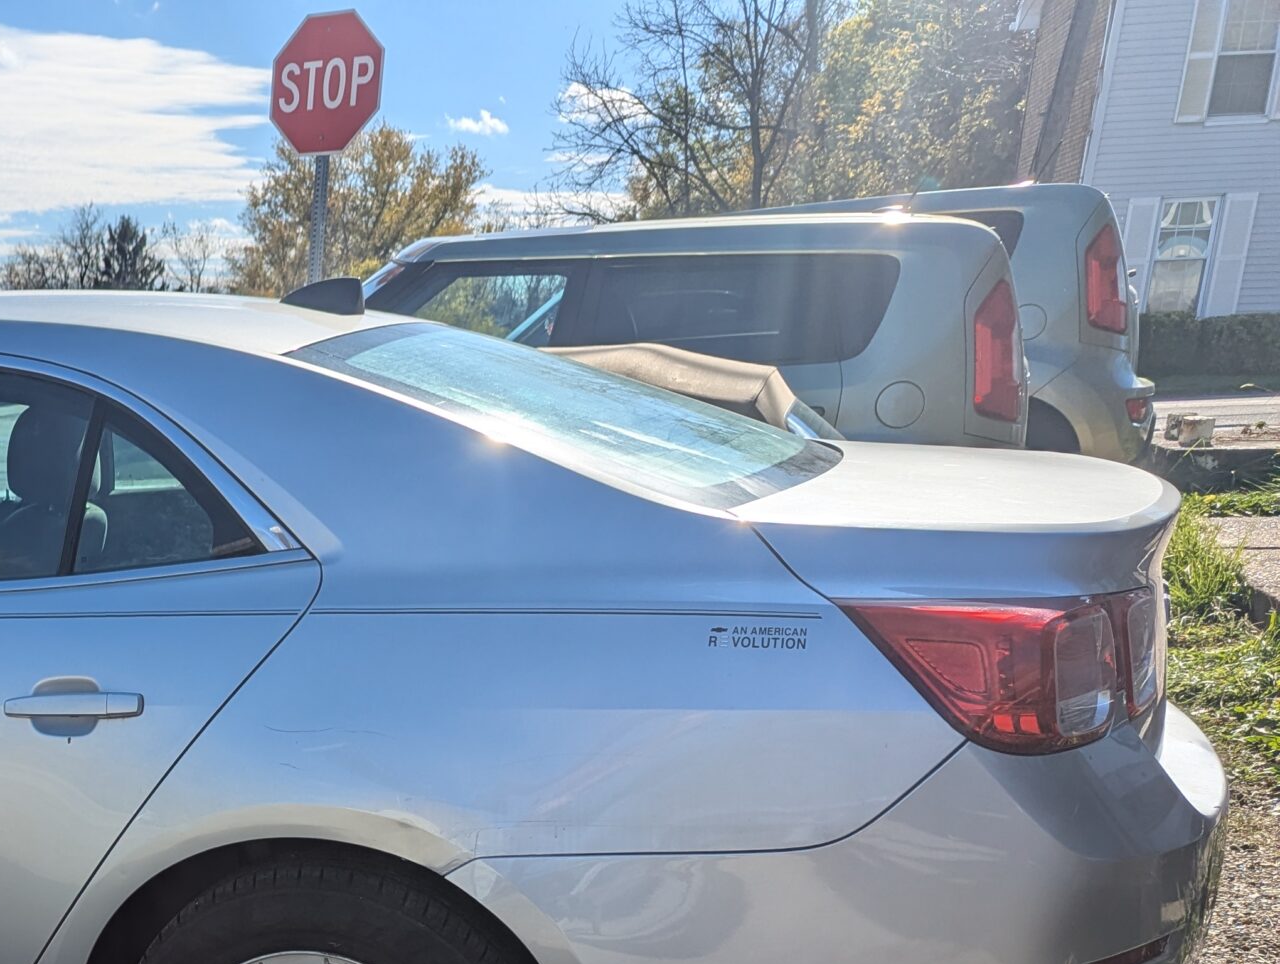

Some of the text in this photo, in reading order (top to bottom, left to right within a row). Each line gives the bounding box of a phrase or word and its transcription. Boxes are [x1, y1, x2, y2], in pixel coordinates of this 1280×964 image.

[278, 55, 375, 114] STOP
[732, 626, 808, 637] AN AMERICAN
